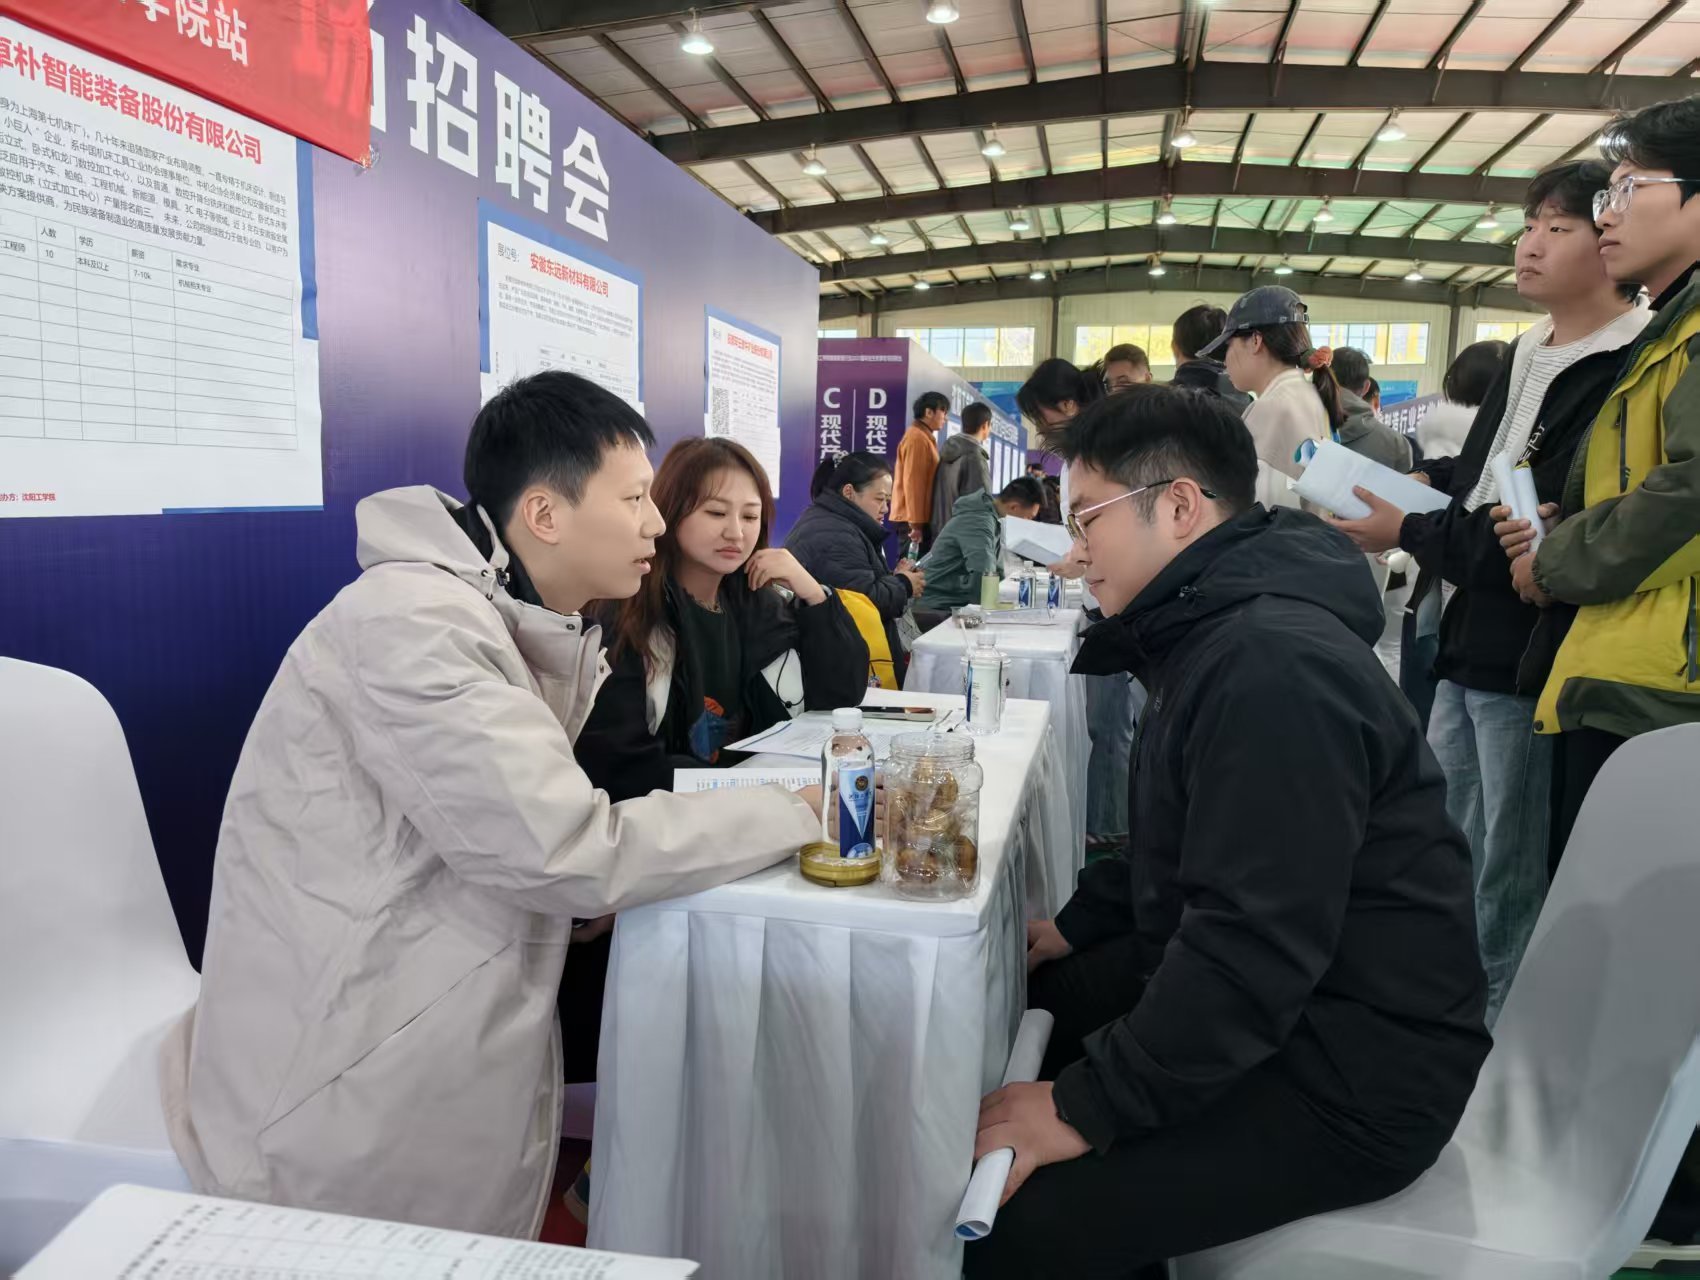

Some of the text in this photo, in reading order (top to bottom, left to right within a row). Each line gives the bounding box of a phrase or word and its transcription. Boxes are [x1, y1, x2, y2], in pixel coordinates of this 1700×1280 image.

[370, 8, 609, 242] 招聘会
[41, 226, 56, 239] 人数
[79, 236, 93, 248] 学历
[45, 249, 54, 259] 10
[76, 257, 109, 272] 本科及以上
[823, 387, 841, 409] C
[868, 388, 887, 409] D
